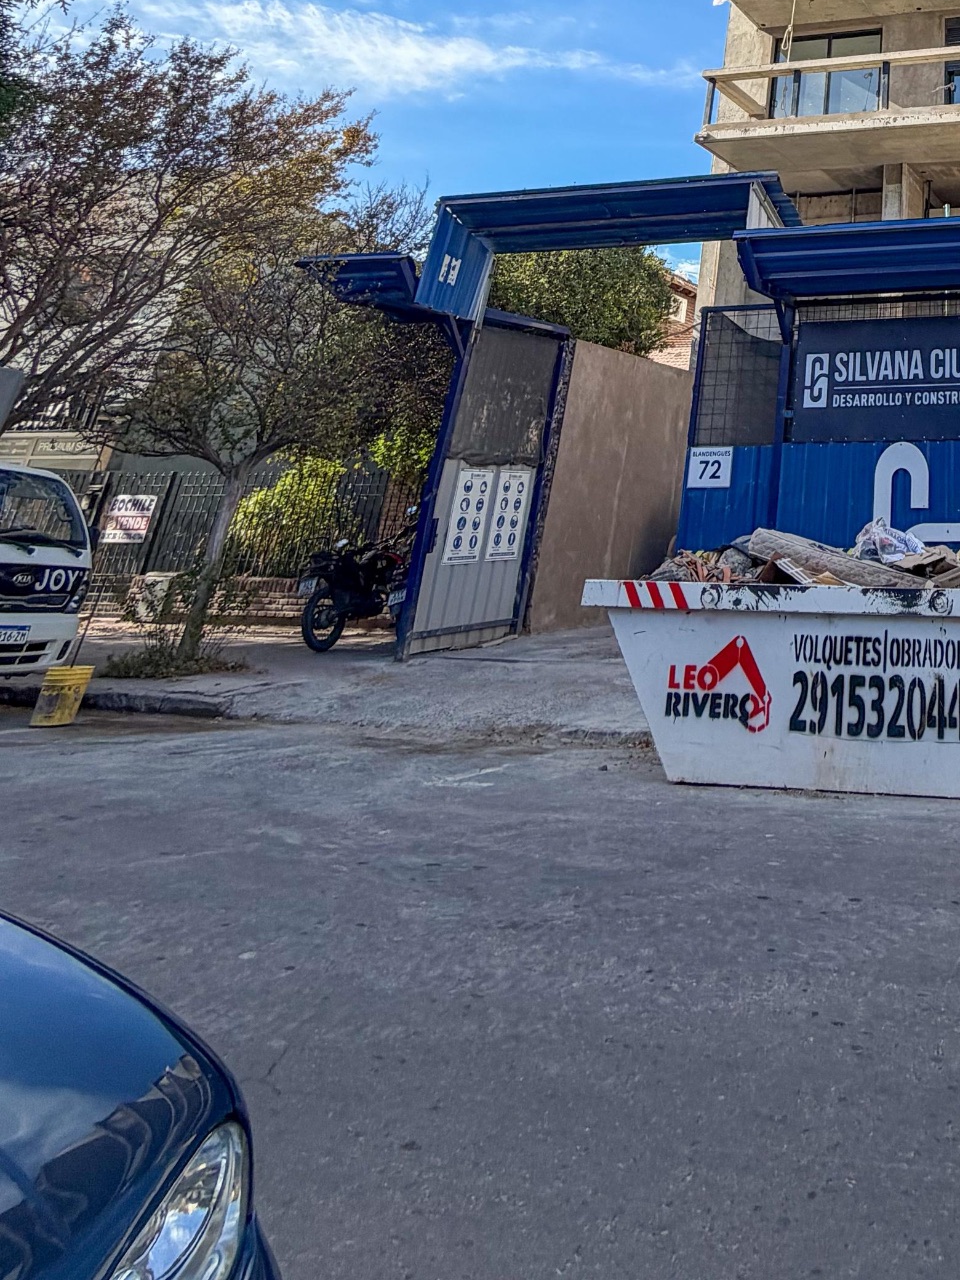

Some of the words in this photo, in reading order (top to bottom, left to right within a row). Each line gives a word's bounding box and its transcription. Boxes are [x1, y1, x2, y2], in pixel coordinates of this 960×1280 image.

[833, 349, 924, 382] SILVANA
[832, 392, 902, 407] DESARROLLO
[904, 392, 912, 405] Y
[699, 460, 721, 479] 72
[668, 664, 719, 691] LEO
[665, 692, 760, 727] RIVERO
